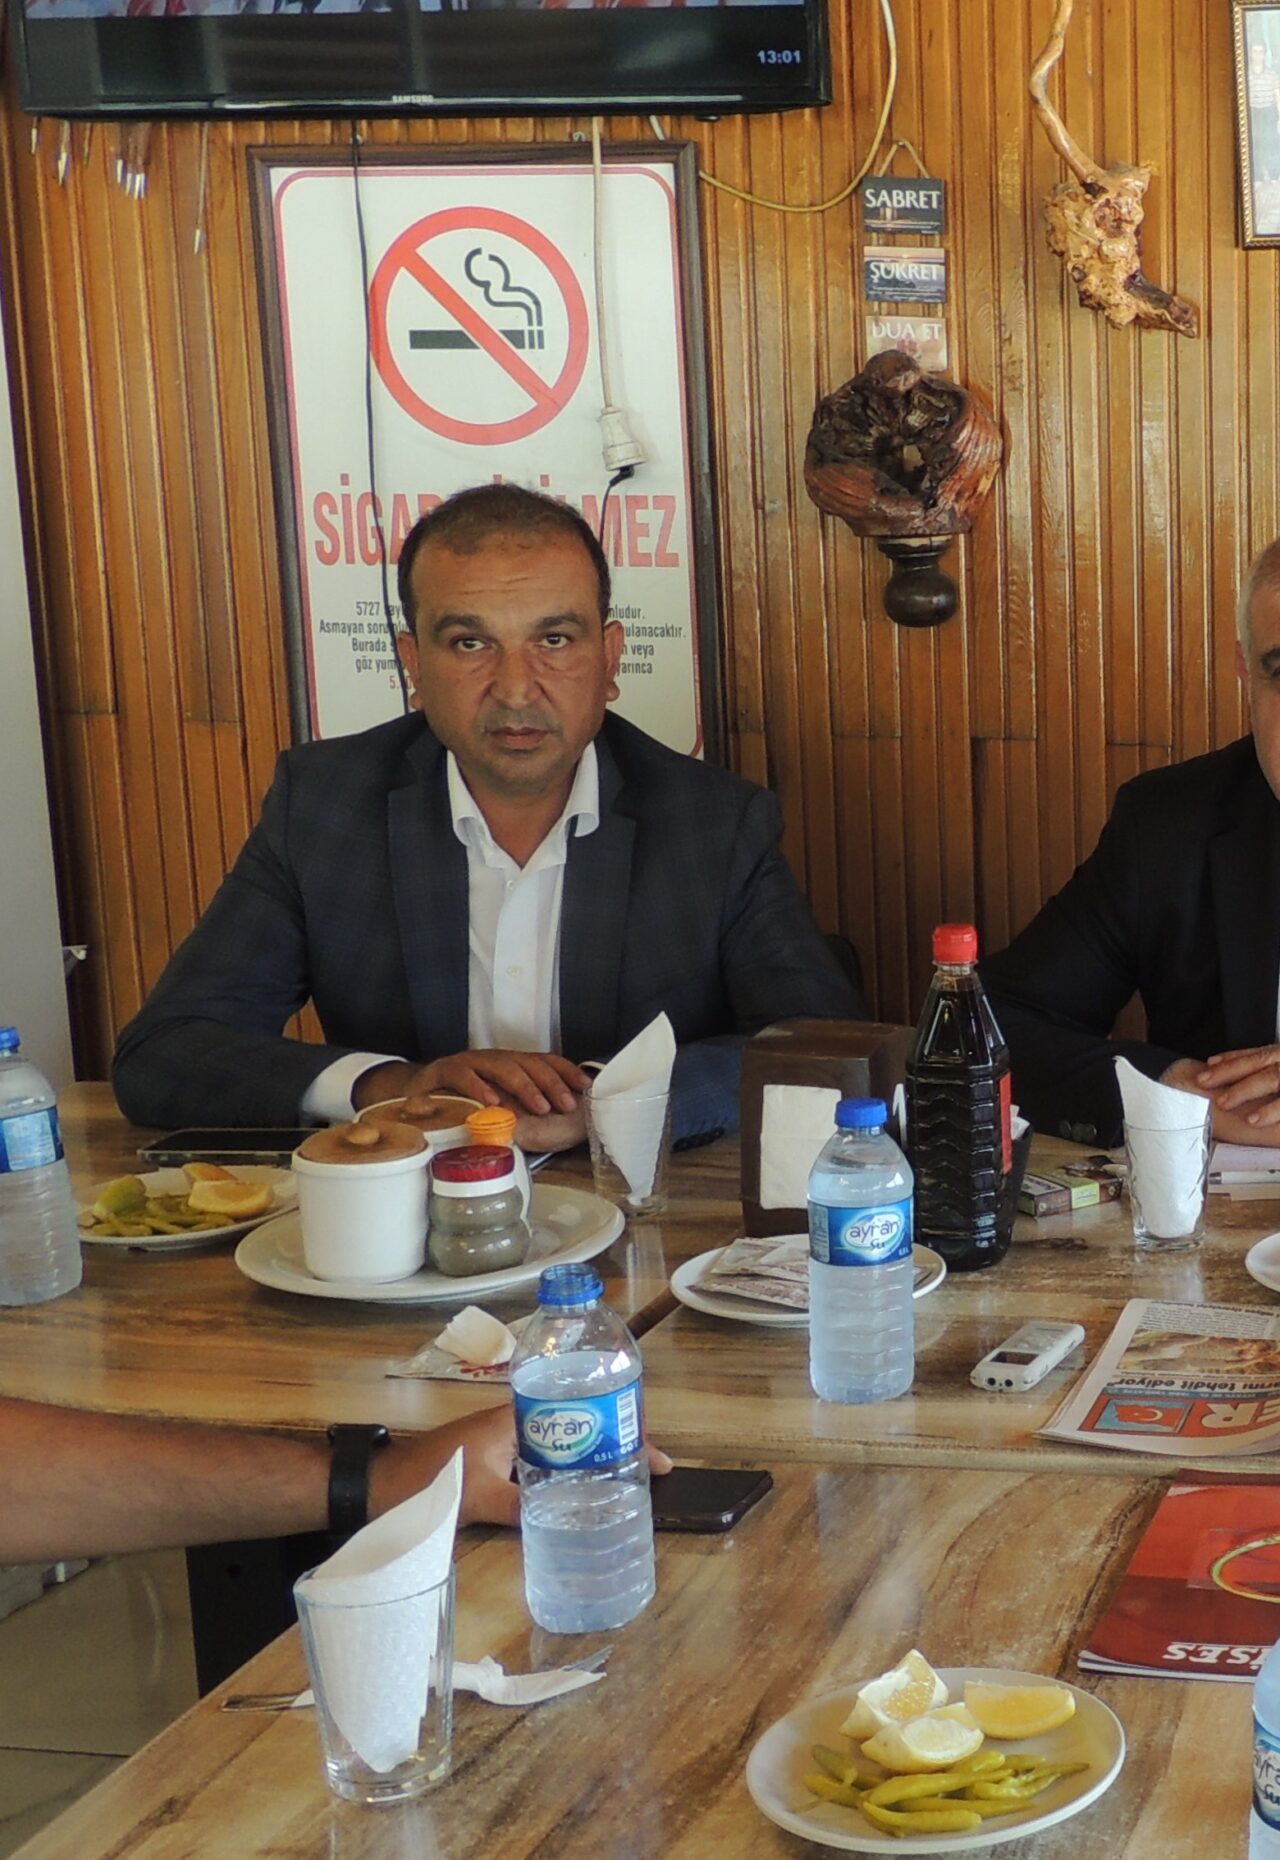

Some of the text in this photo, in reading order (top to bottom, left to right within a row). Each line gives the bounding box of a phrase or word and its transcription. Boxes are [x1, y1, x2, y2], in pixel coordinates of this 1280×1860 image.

[757, 50, 800, 64] 13:01
[865, 189, 941, 209] SABRET
[872, 322, 942, 340] DUA ET
[313, 473, 444, 566] SİGA
[356, 602, 380, 616] 5727
[608, 604, 646, 619] nludur.
[319, 620, 365, 636] Asmayan
[625, 623, 687, 638] ulanacaktır.
[352, 638, 387, 652] Burada
[631, 644, 655, 659] veya
[355, 655, 373, 673] göz
[616, 662, 653, 677] arınca
[849, 1219, 899, 1243] ayran
[1181, 1380, 1236, 1392] tehdit
[529, 1418, 593, 1442] ayran
